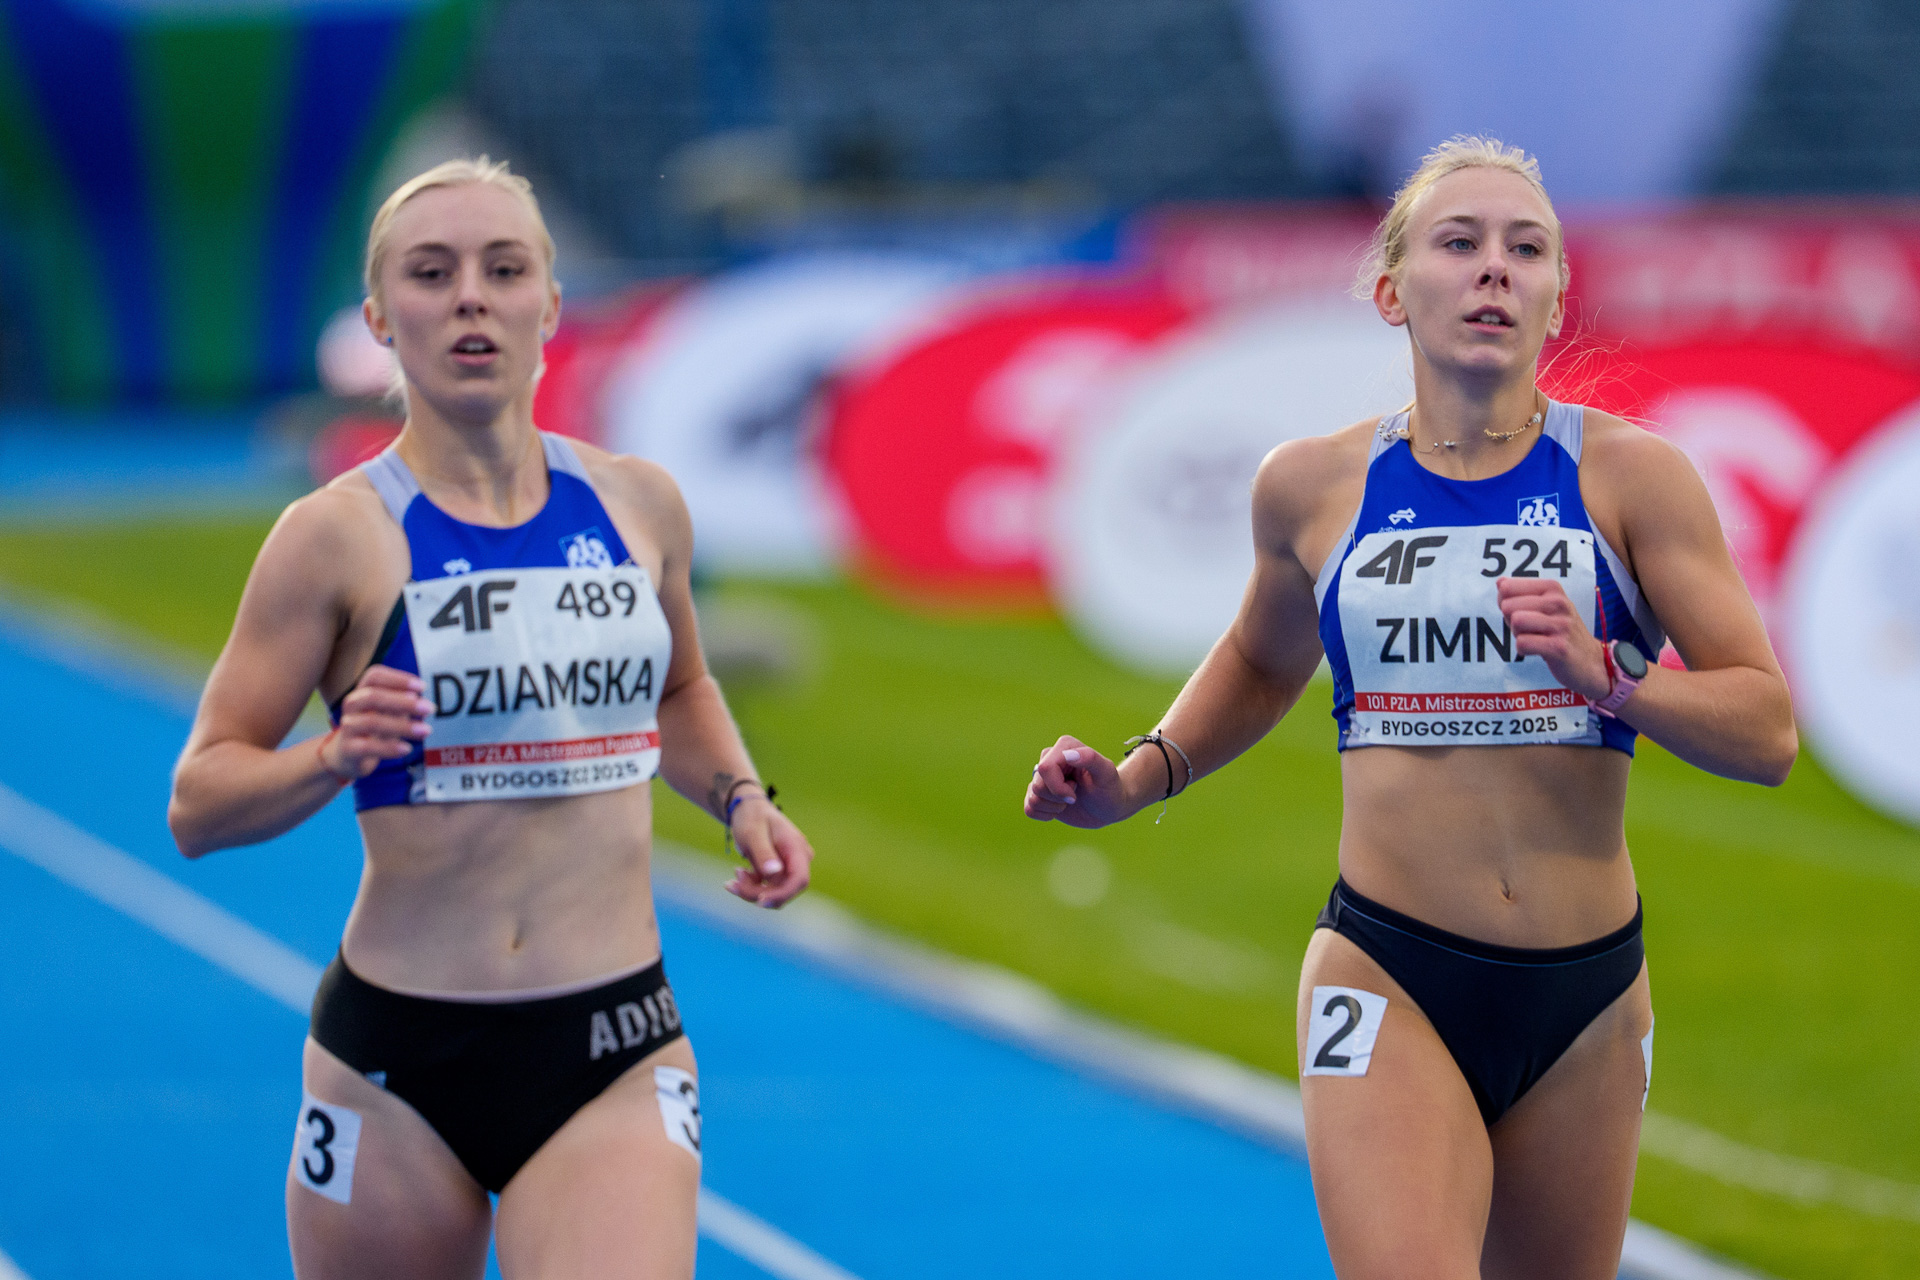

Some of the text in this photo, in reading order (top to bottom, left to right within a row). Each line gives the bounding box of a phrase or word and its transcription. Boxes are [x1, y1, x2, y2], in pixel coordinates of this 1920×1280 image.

[1356, 535, 1448, 584] 4F
[1480, 537, 1572, 578] 524
[429, 580, 516, 632] 4F
[556, 581, 637, 619] 489
[1376, 617, 1525, 663] ZIMN
[432, 658, 654, 719] DZIAMSKA
[1367, 691, 1574, 711] 101. PZLA Mistrzostwa Polski
[1381, 716, 1558, 736] BYDGOSZCZ 2025
[461, 760, 638, 790] BYDGOSZCZ 2025
[1313, 994, 1363, 1068] 2
[303, 1108, 335, 1186] 3
